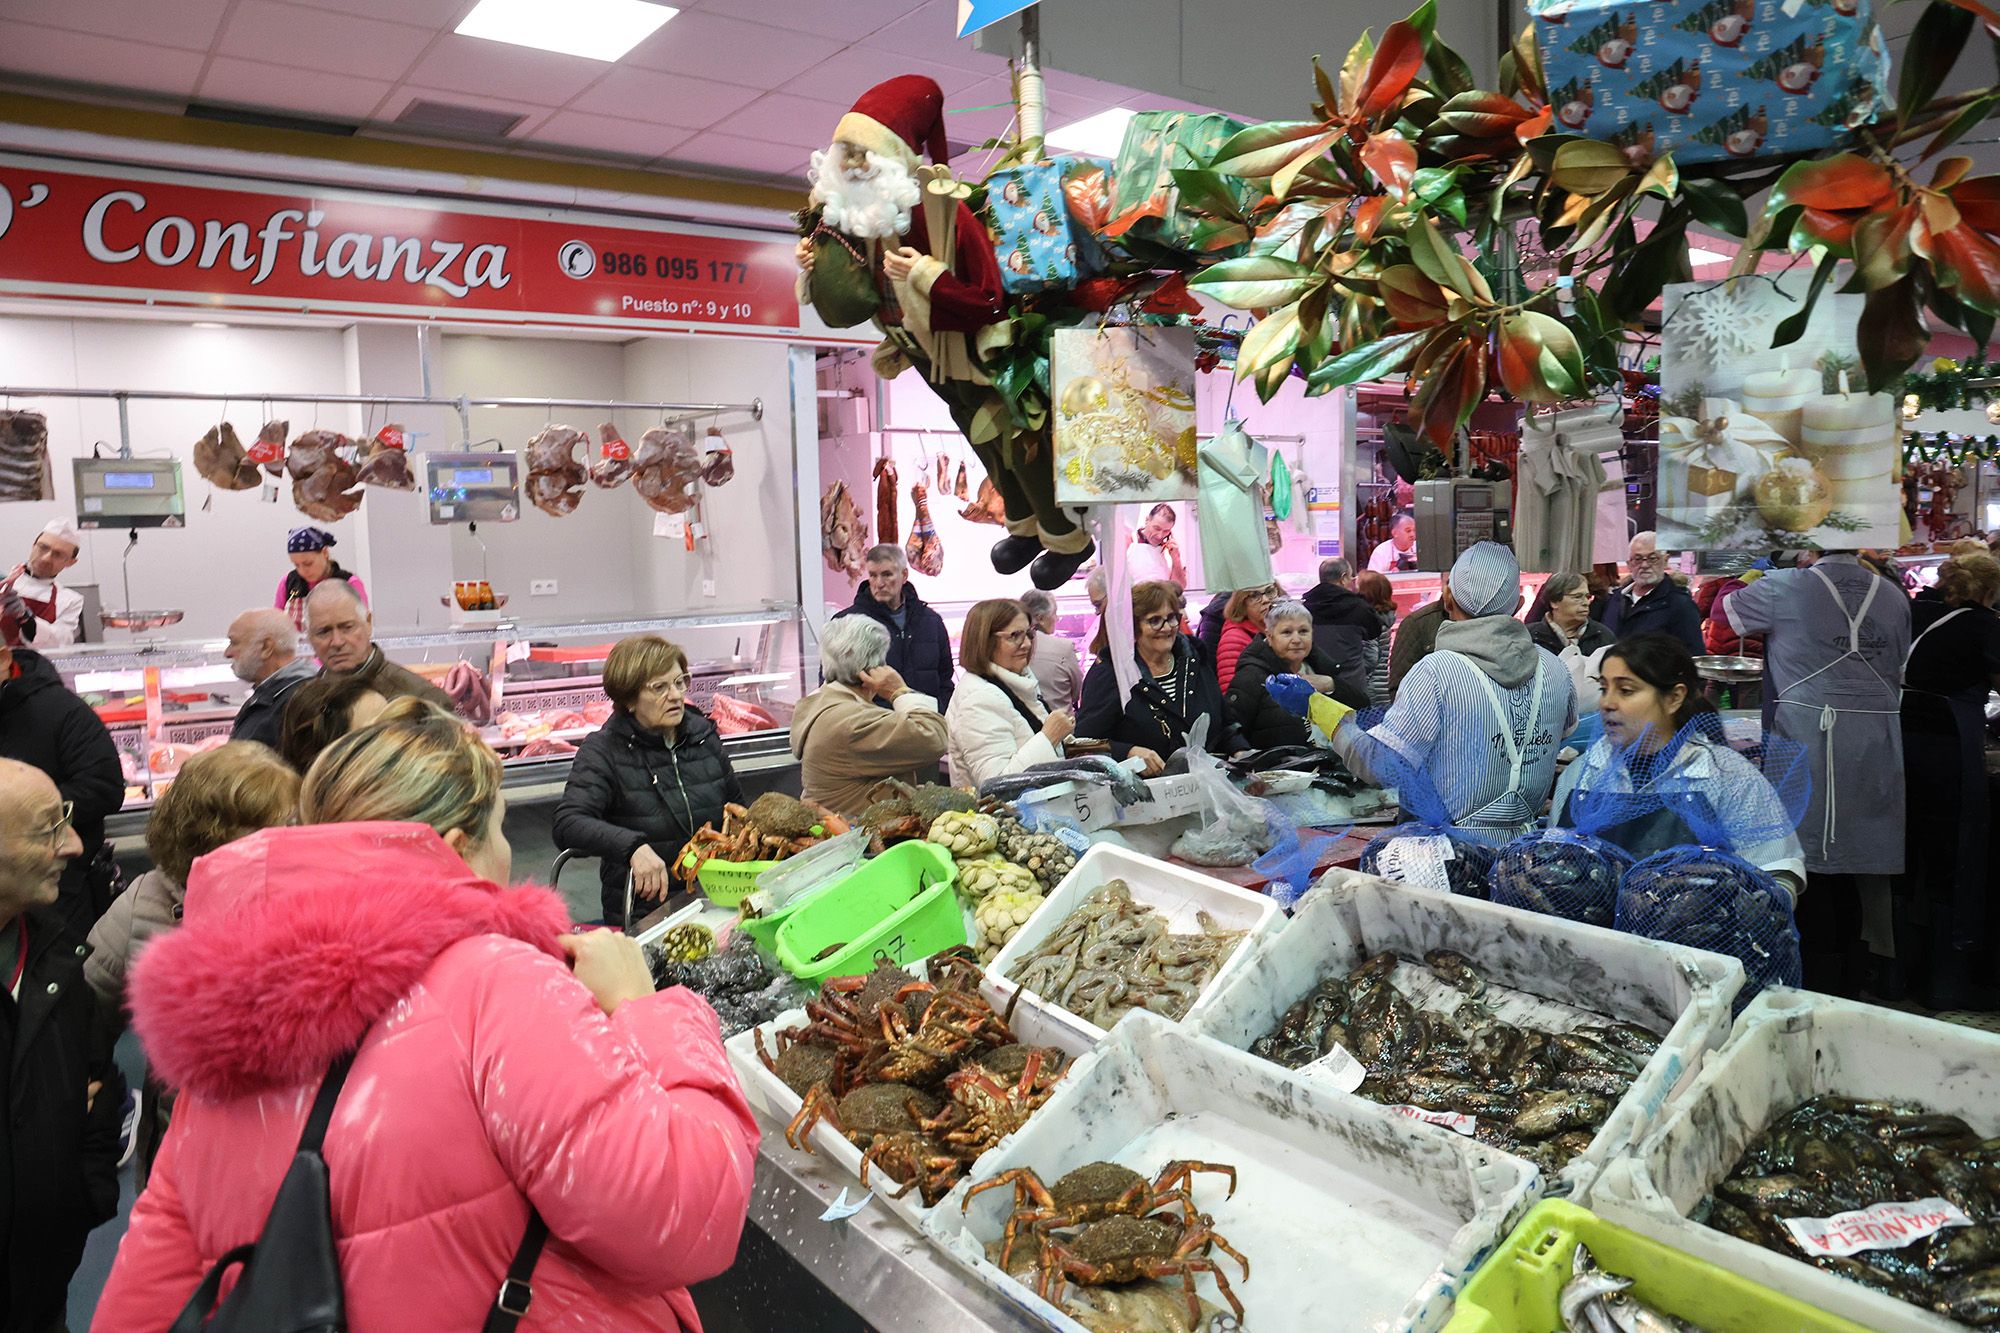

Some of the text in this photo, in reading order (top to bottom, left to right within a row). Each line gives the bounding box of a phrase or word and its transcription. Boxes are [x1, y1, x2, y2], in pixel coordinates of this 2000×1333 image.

[83, 190, 512, 298] Confianza
[602, 252, 748, 284] 986 095 177
[621, 295, 678, 314] Puesto
[706, 303, 717, 316] 9
[719, 304, 729, 319] y
[732, 302, 751, 318] 10
[1164, 783, 1200, 799] HUELVA
[1074, 793, 1091, 822] 5
[1808, 1211, 1950, 1251] MANUELA
